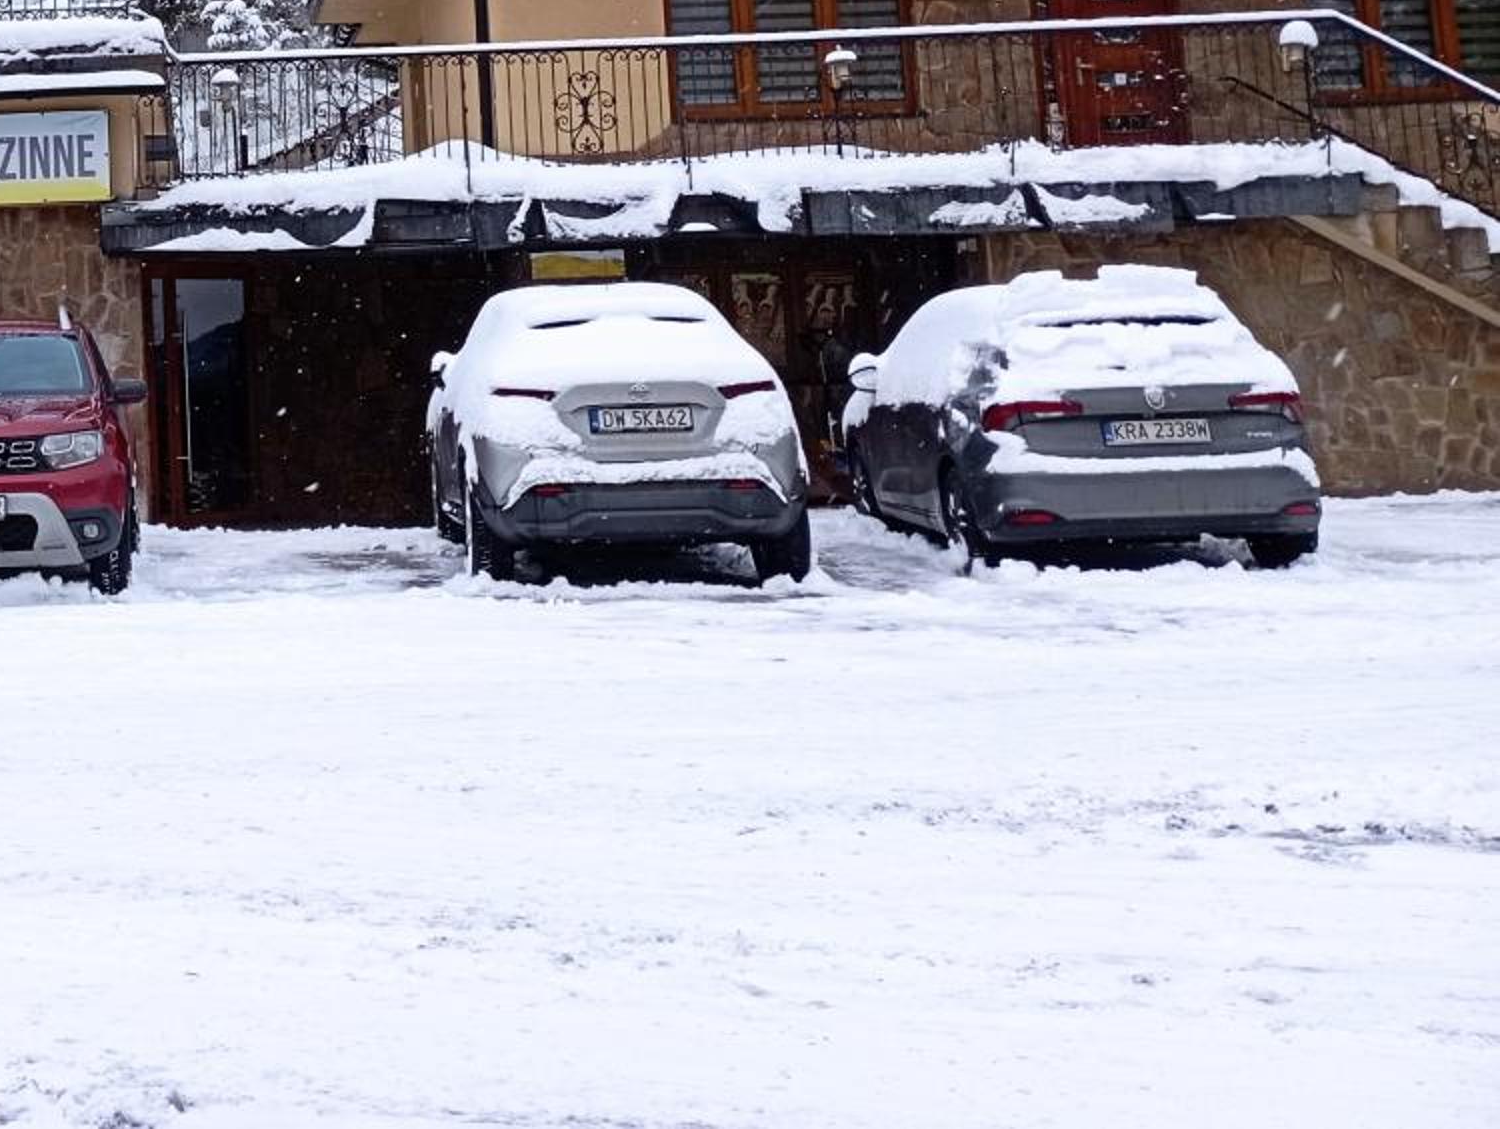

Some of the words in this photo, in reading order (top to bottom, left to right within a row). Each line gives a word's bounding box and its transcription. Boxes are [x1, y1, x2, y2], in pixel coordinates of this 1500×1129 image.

[603, 411, 624, 427] DW
[632, 409, 687, 426] 5KA62
[1114, 422, 1149, 440] KRA
[1153, 421, 1209, 438] 2338W
